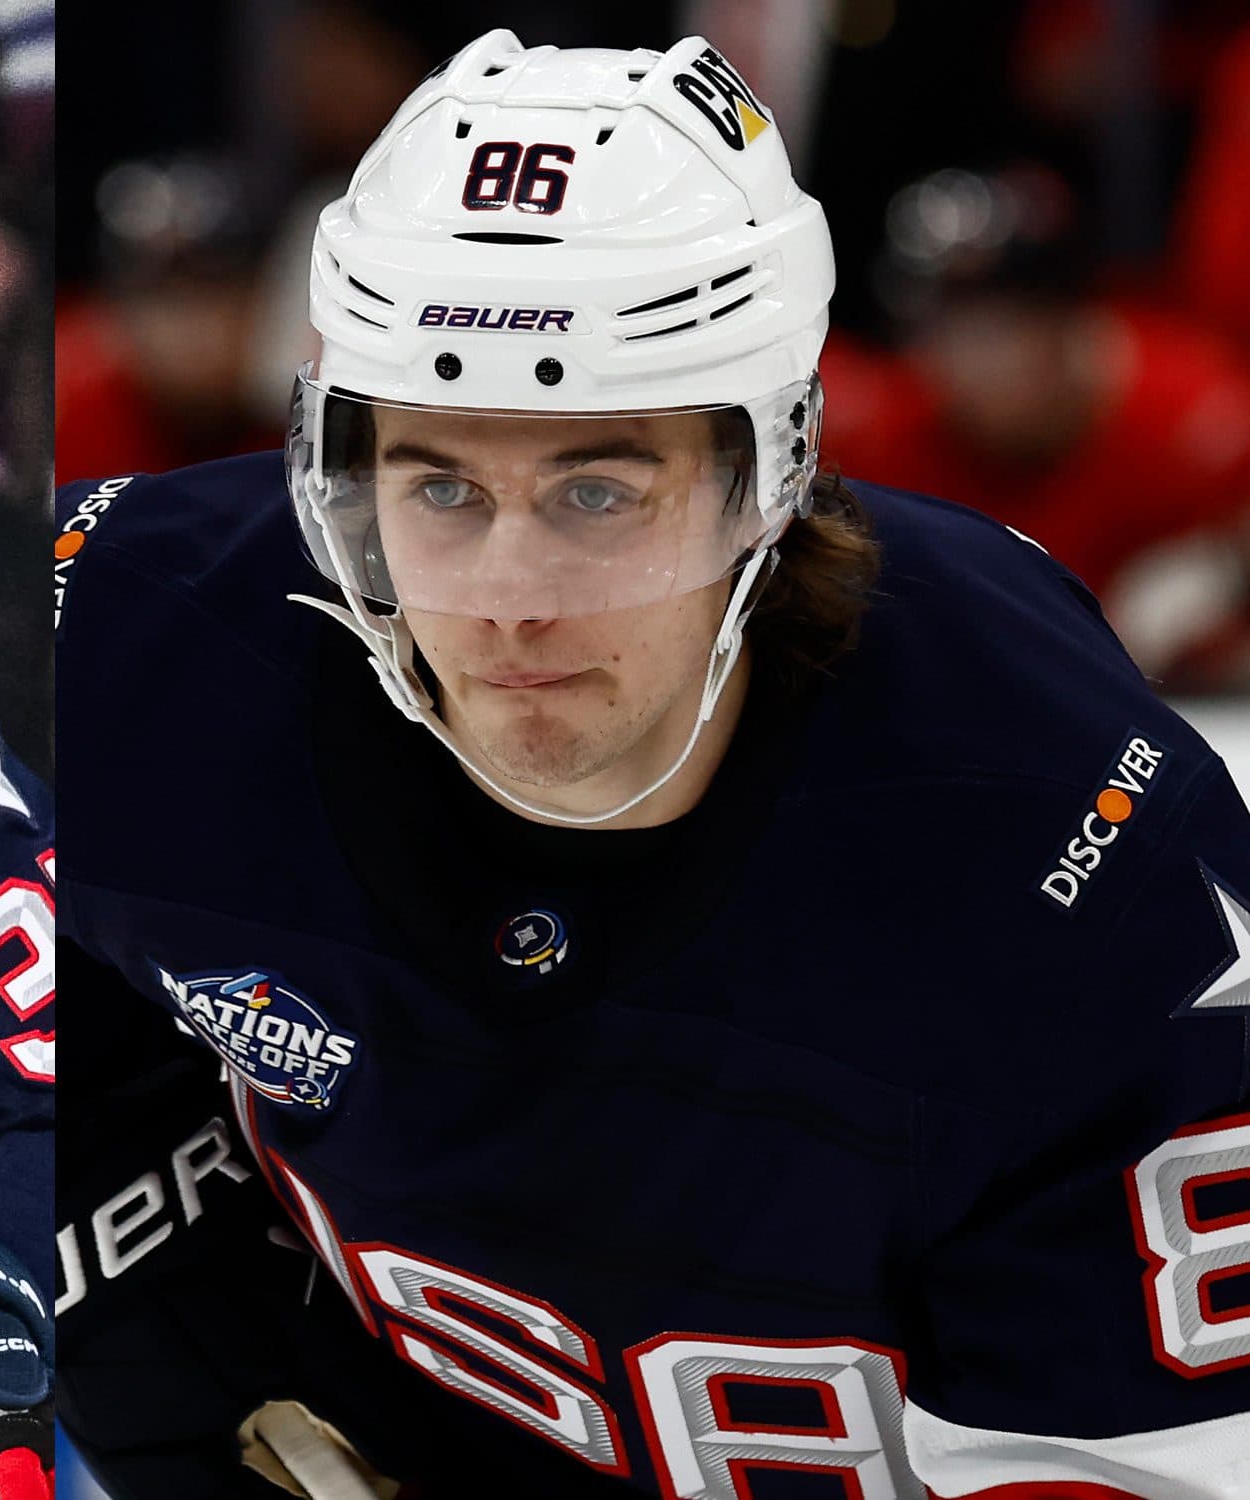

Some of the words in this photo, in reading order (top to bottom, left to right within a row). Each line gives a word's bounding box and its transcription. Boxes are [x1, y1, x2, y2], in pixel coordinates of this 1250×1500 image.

[673, 48, 771, 151] CAT
[462, 141, 575, 215] 86
[417, 304, 575, 332] BAUER
[1041, 736, 1163, 908] DISCOVER
[158, 967, 356, 1066] NATIONS
[191, 1012, 330, 1080] ACE-OFF
